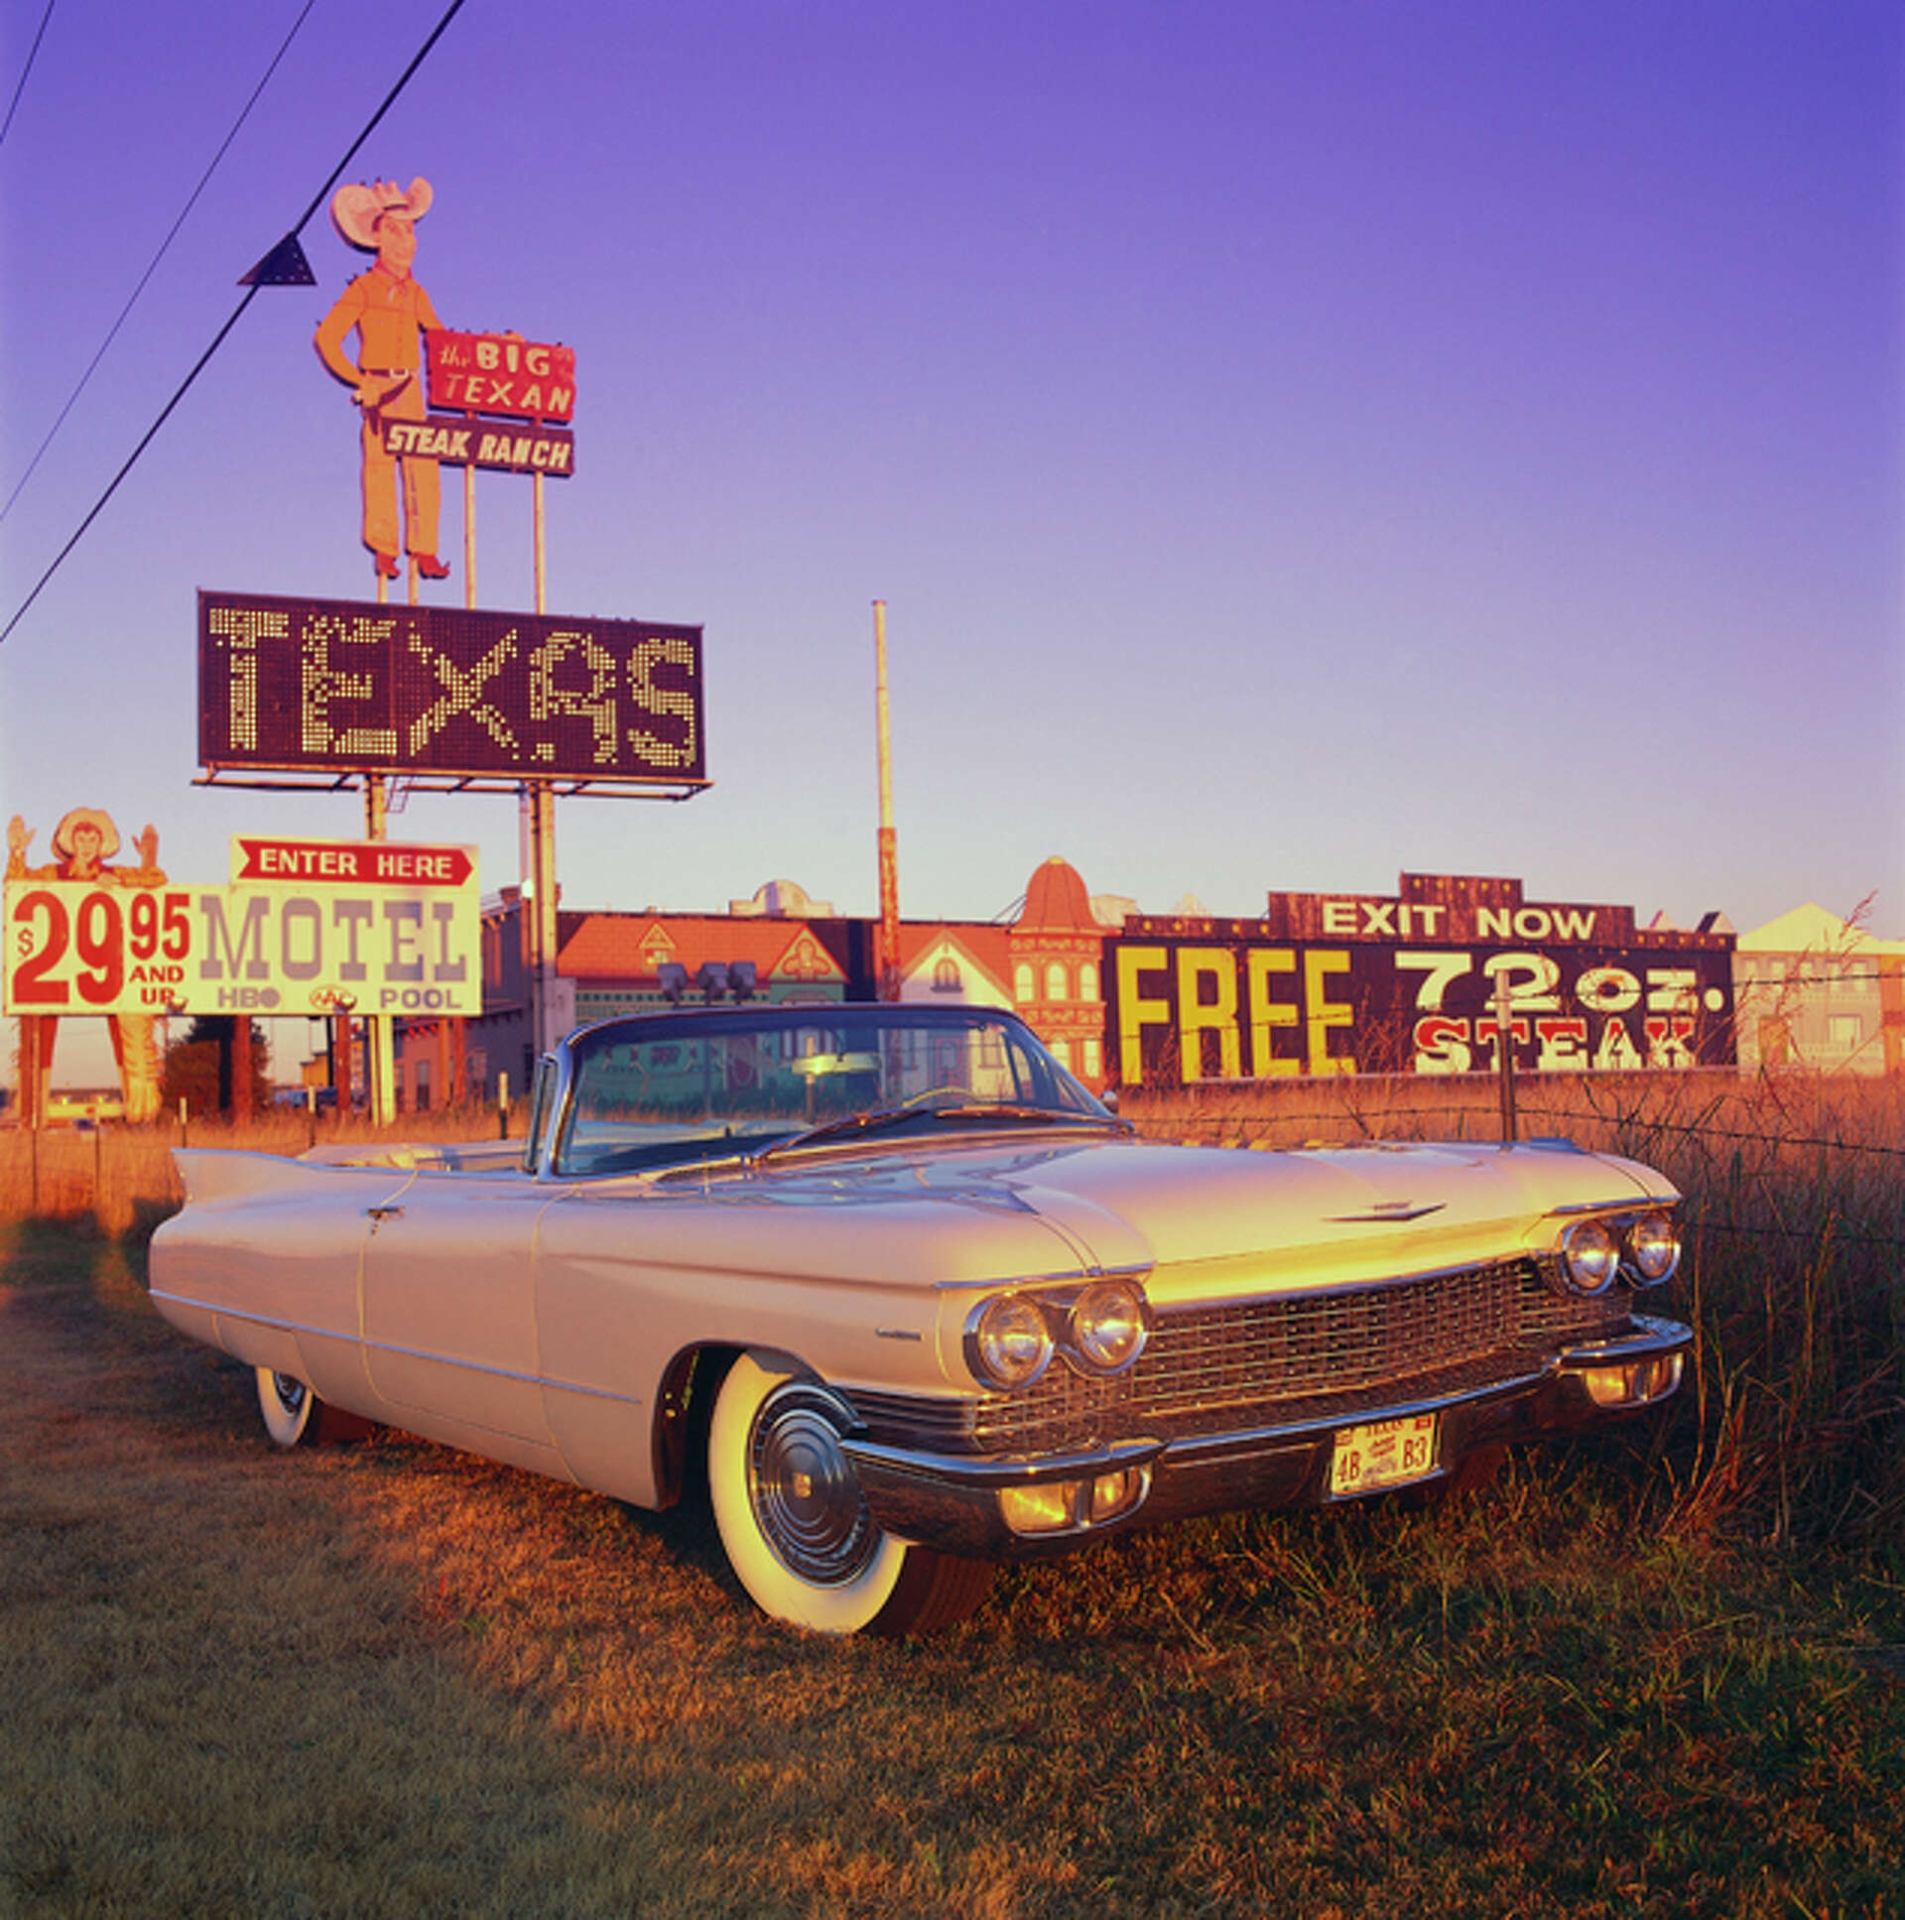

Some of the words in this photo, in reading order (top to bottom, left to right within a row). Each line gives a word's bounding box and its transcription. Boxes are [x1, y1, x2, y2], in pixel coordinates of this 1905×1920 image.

[476, 341, 550, 376] BIG
[444, 373, 571, 412] TEXAN
[386, 425, 472, 458] STEAK
[477, 434, 571, 469] RANCH
[209, 606, 695, 767] TEXAS
[259, 848, 357, 877] ENTER
[377, 854, 453, 879] HERE
[200, 894, 467, 983] MOTEL
[1323, 902, 1445, 936] EXIT
[1478, 907, 1596, 941] NOW
[129, 965, 184, 984] AND
[1395, 951, 1562, 1013] 72
[1575, 967, 1724, 1012] oz.
[218, 986, 281, 1009] HBO
[380, 988, 462, 1009] POOL
[1116, 945, 1357, 1085] FREE
[1413, 1015, 1697, 1075] STEAK
